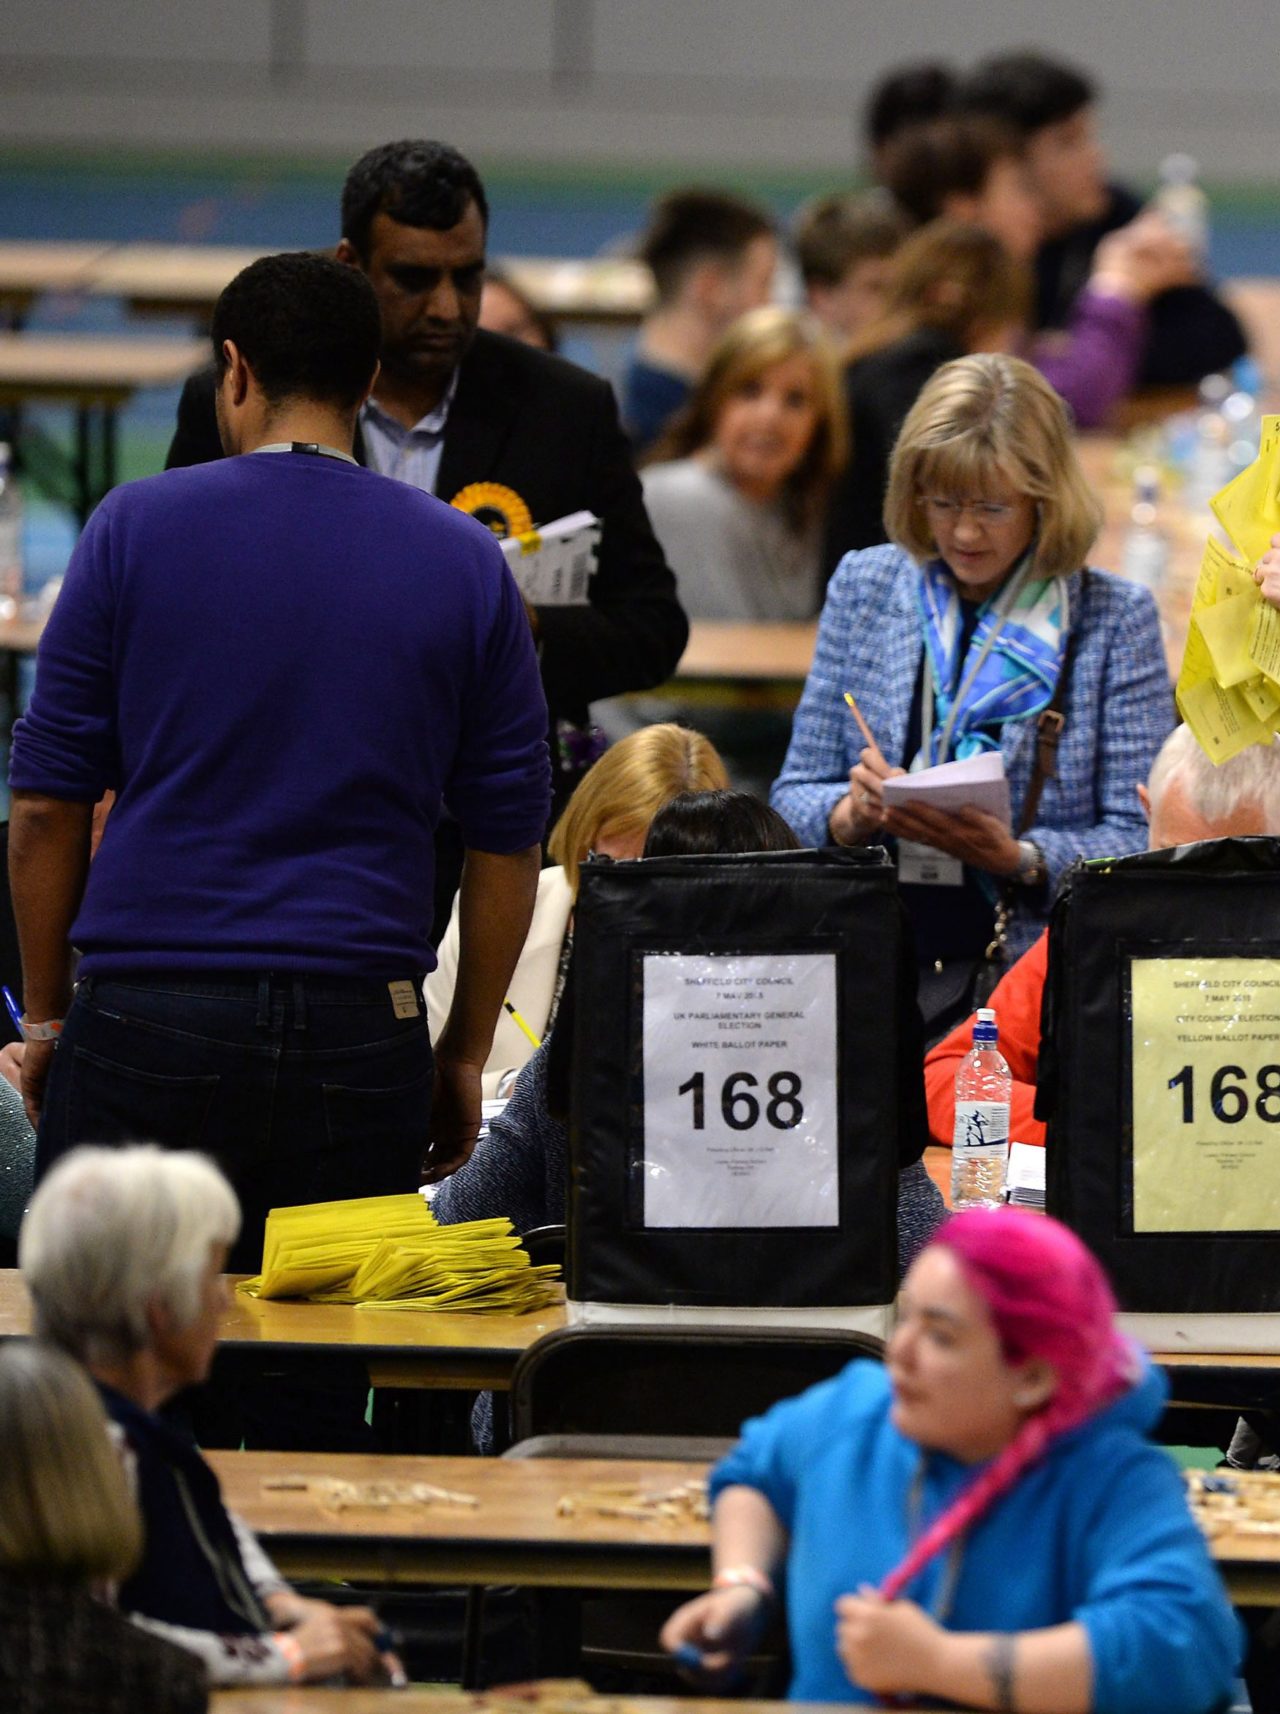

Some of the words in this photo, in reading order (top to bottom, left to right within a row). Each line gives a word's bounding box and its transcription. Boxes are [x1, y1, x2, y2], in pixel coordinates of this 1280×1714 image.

[1173, 980, 1221, 989] SHEFFELD
[1222, 980, 1241, 988] CITY
[673, 1012, 685, 1020] UK
[688, 1012, 761, 1020] PARLIAMENTARY
[764, 1011, 804, 1019] GENERAL
[718, 1022, 762, 1030] ELECTION
[1177, 1034, 1213, 1042] YELLOW
[1215, 1034, 1249, 1042] BALLOT
[1252, 1033, 1280, 1041] PAPER
[691, 1041, 719, 1049] WHITE
[721, 1041, 755, 1049] BALLOT
[758, 1040, 788, 1048] PAPER
[678, 1070, 804, 1131] 168
